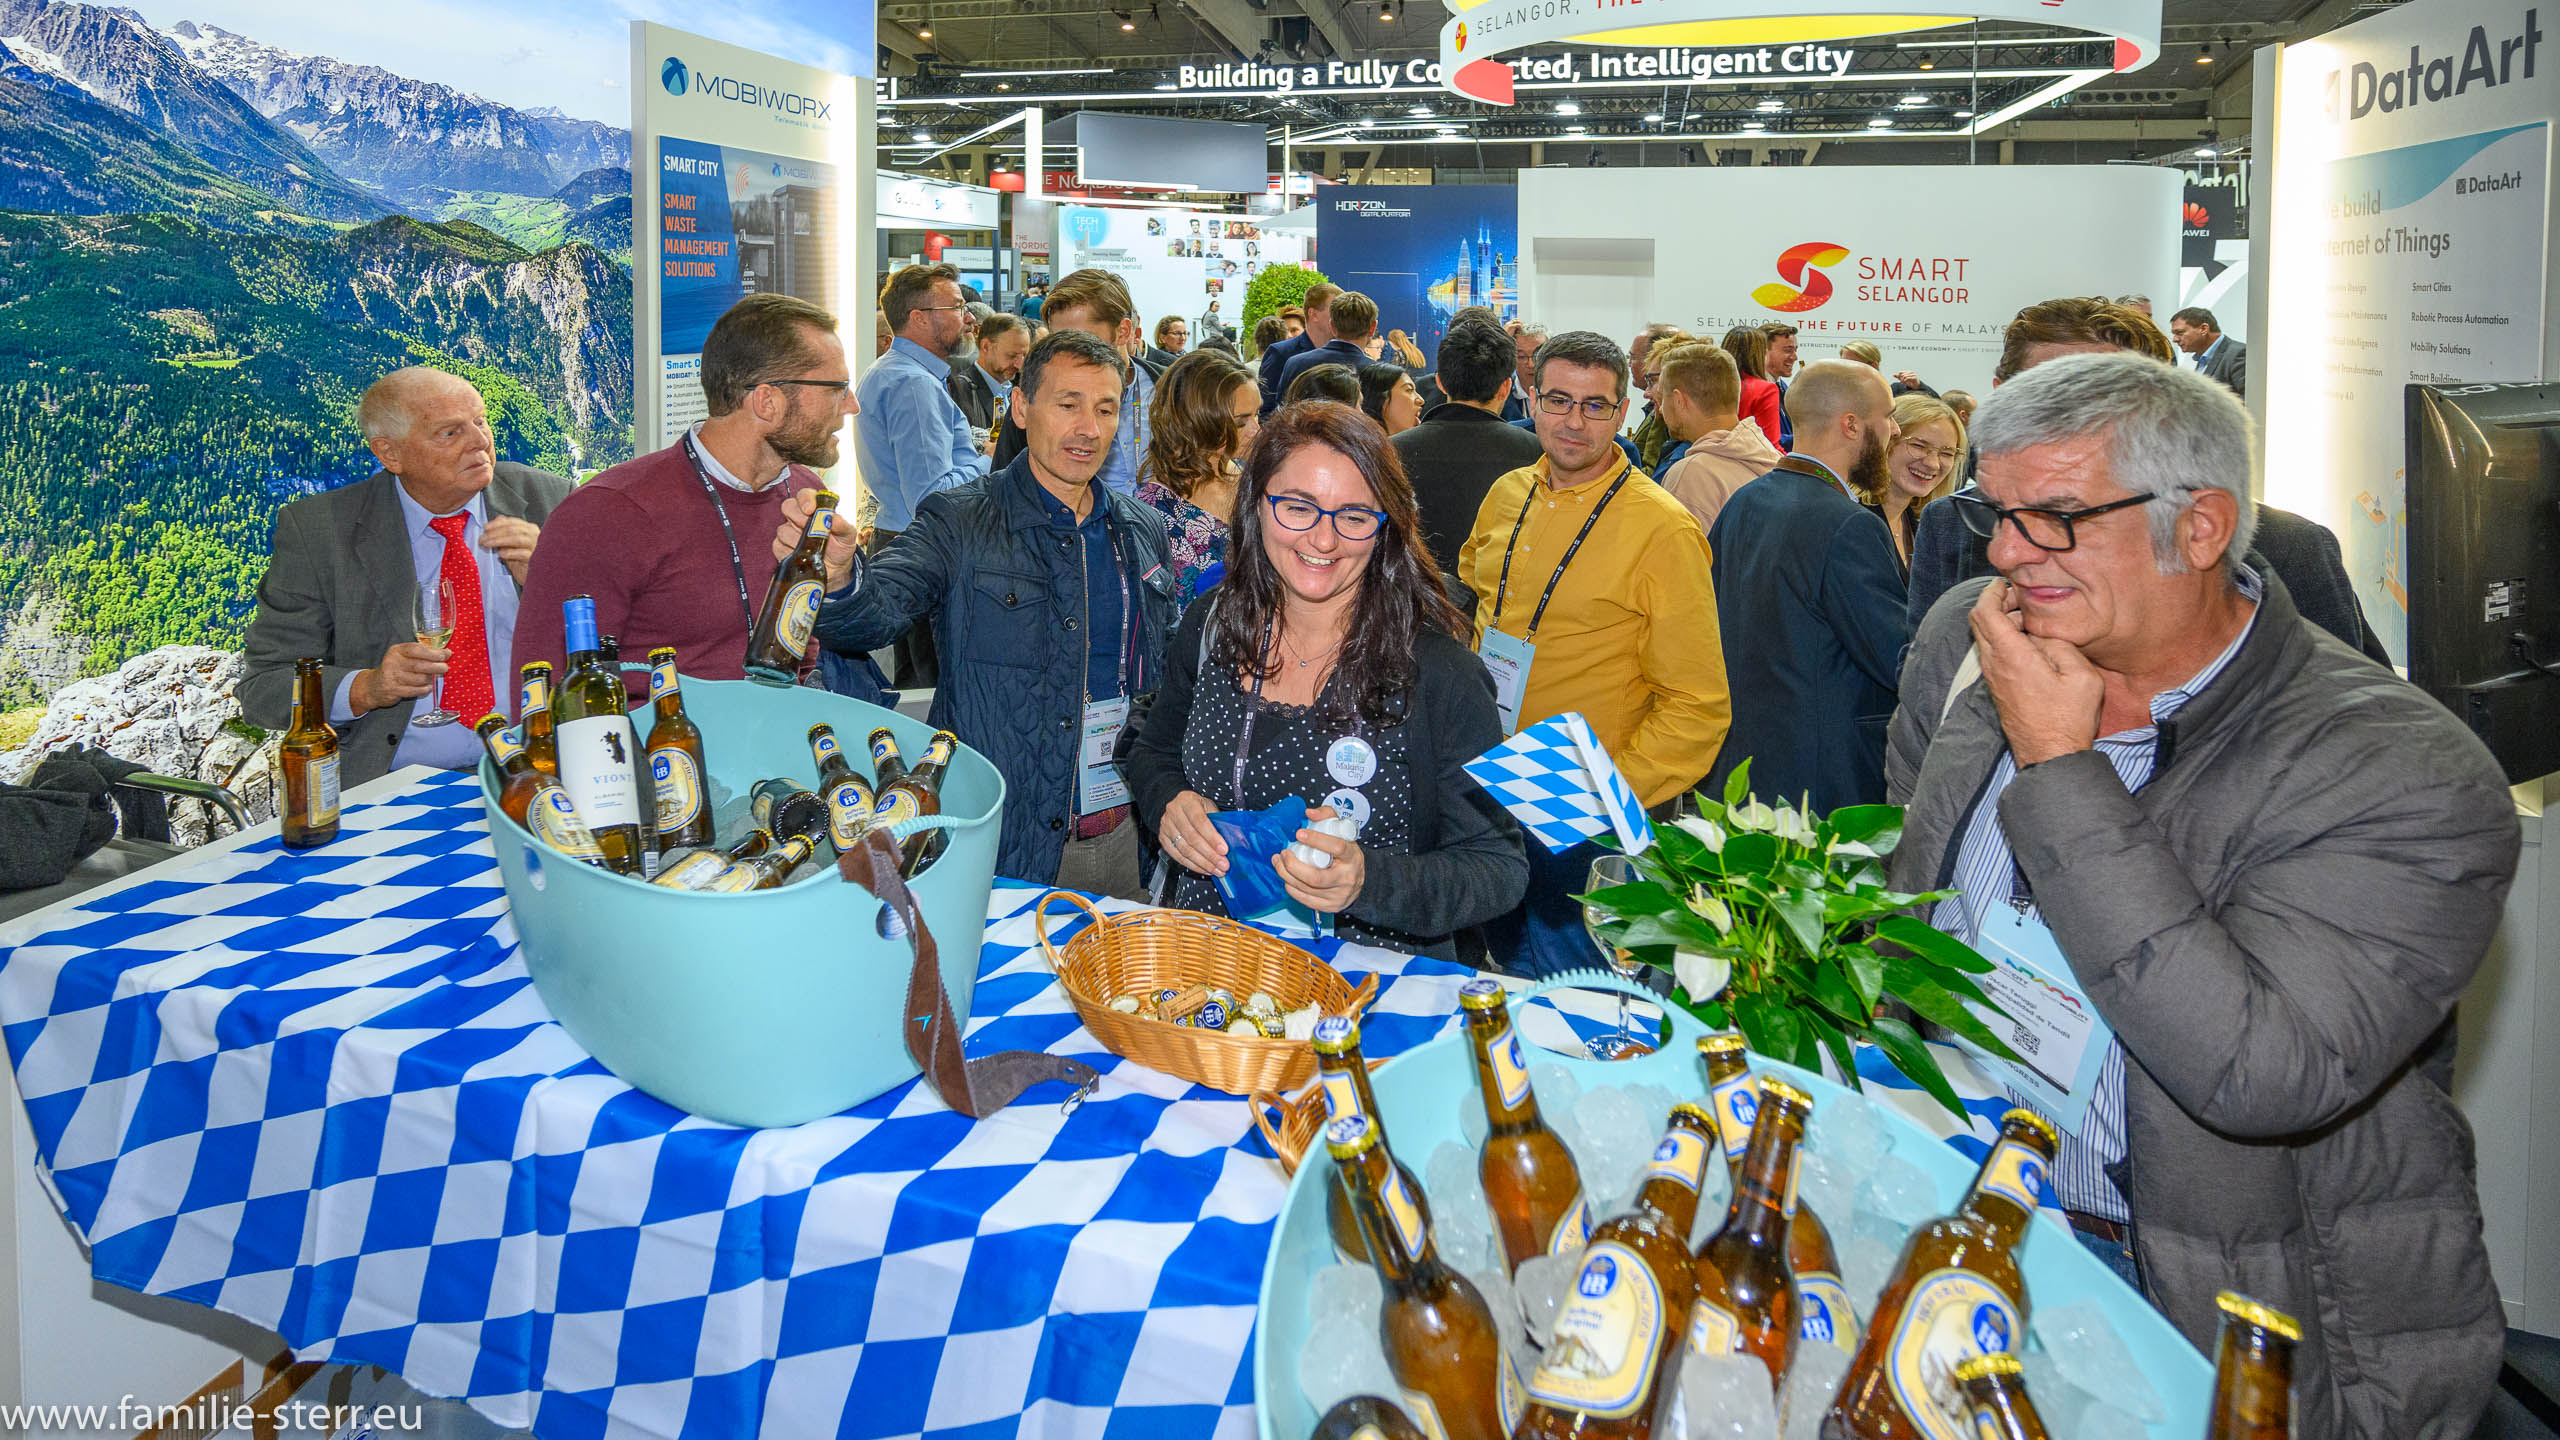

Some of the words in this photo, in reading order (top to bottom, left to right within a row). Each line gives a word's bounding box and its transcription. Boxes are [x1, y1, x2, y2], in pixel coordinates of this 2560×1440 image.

[1180, 63, 1294, 91] Building
[1302, 68, 1318, 85] a
[1328, 60, 1399, 89] Fully
[1406, 53, 1580, 84] Cocted,
[1591, 48, 1771, 80] Intelligent
[1780, 44, 1854, 76] City
[2350, 8, 2542, 120] DataArt
[696, 72, 831, 121] MOBIWORX
[876, 77, 898, 100] EI
[664, 155, 696, 174] SMART
[698, 160, 718, 177] CITY
[2469, 171, 2522, 193] DataArt
[664, 193, 697, 211] SMART
[1335, 200, 1386, 211] HORIZON
[2343, 190, 2381, 218] build
[664, 216, 697, 233] WASTE
[2183, 229, 2210, 237] AWEI
[664, 239, 729, 257] MANAGEMENT
[1015, 242, 1049, 250] NORDIC
[2375, 228, 2391, 254] of
[2395, 226, 2450, 259] Things
[664, 262, 716, 278] SOLUTIONS
[1858, 257, 1969, 281] SMART
[1857, 285, 1969, 304] SELANGOR
[2412, 282, 2432, 292] Smart
[2433, 281, 2452, 292] Cities
[1797, 320, 1828, 331] THE
[1837, 321, 1903, 332] FUTURE
[1912, 322, 1932, 333] OF
[1942, 323, 2008, 335] MALAYS
[2411, 312, 2436, 322] Robotic
[2437, 312, 2463, 323] Process
[2464, 313, 2509, 325] Automation
[2410, 341, 2438, 356] Mobility
[2439, 343, 2471, 355] Solutions
[666, 360, 692, 370] Smart
[2409, 370, 2429, 382] Smart
